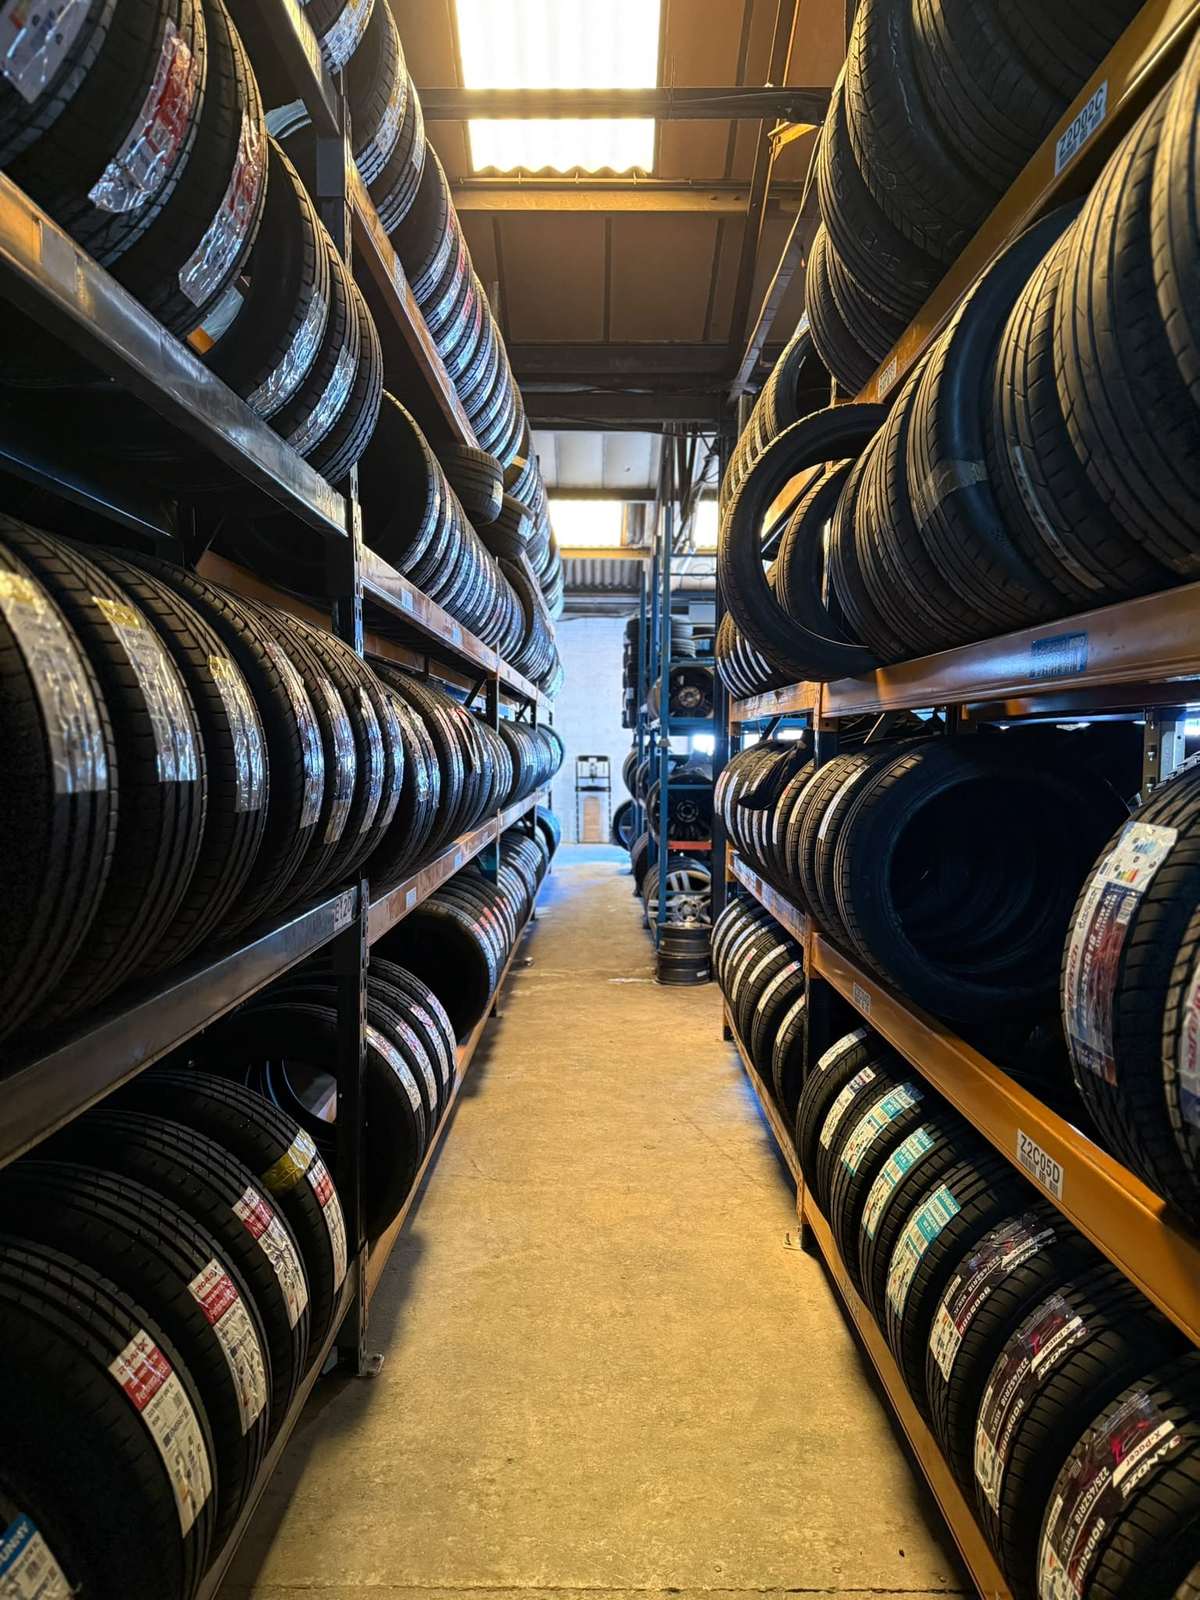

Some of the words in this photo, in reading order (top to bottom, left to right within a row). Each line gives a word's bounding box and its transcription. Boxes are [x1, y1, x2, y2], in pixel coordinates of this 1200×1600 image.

[1020, 1134, 1060, 1184] Z2C05D
[1125, 1430, 1162, 1467] X-Pacer
[1073, 1465, 1111, 1525] 225/45ZR18
